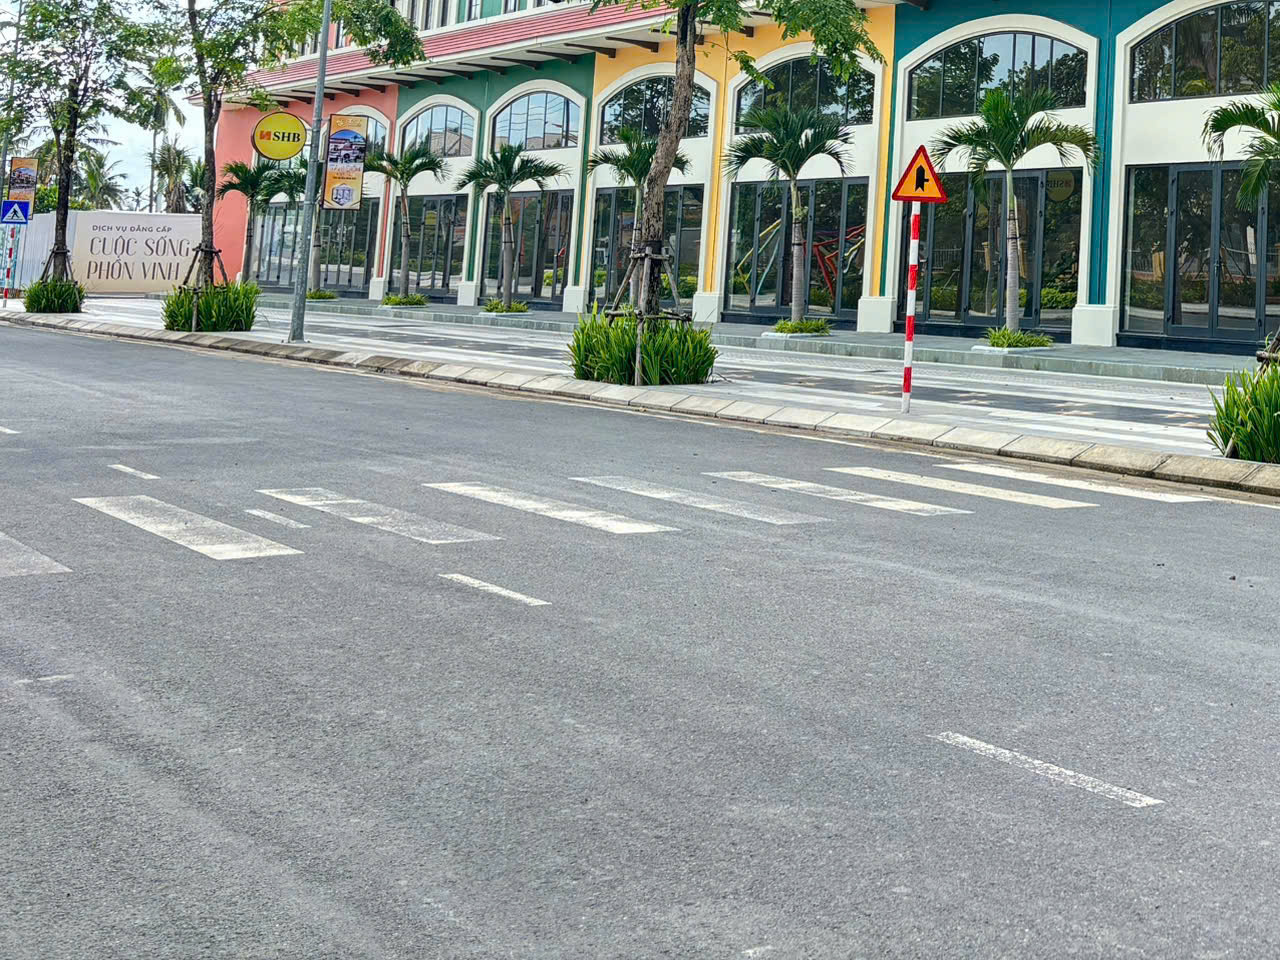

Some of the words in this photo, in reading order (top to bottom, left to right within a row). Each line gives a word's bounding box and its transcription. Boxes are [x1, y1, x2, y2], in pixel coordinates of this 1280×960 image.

[272, 130, 301, 142] SHB
[156, 225, 172, 233] CẤP
[90, 235, 137, 258] CUỘC
[144, 235, 190, 257] SỐNG
[142, 262, 180, 281] VINH
